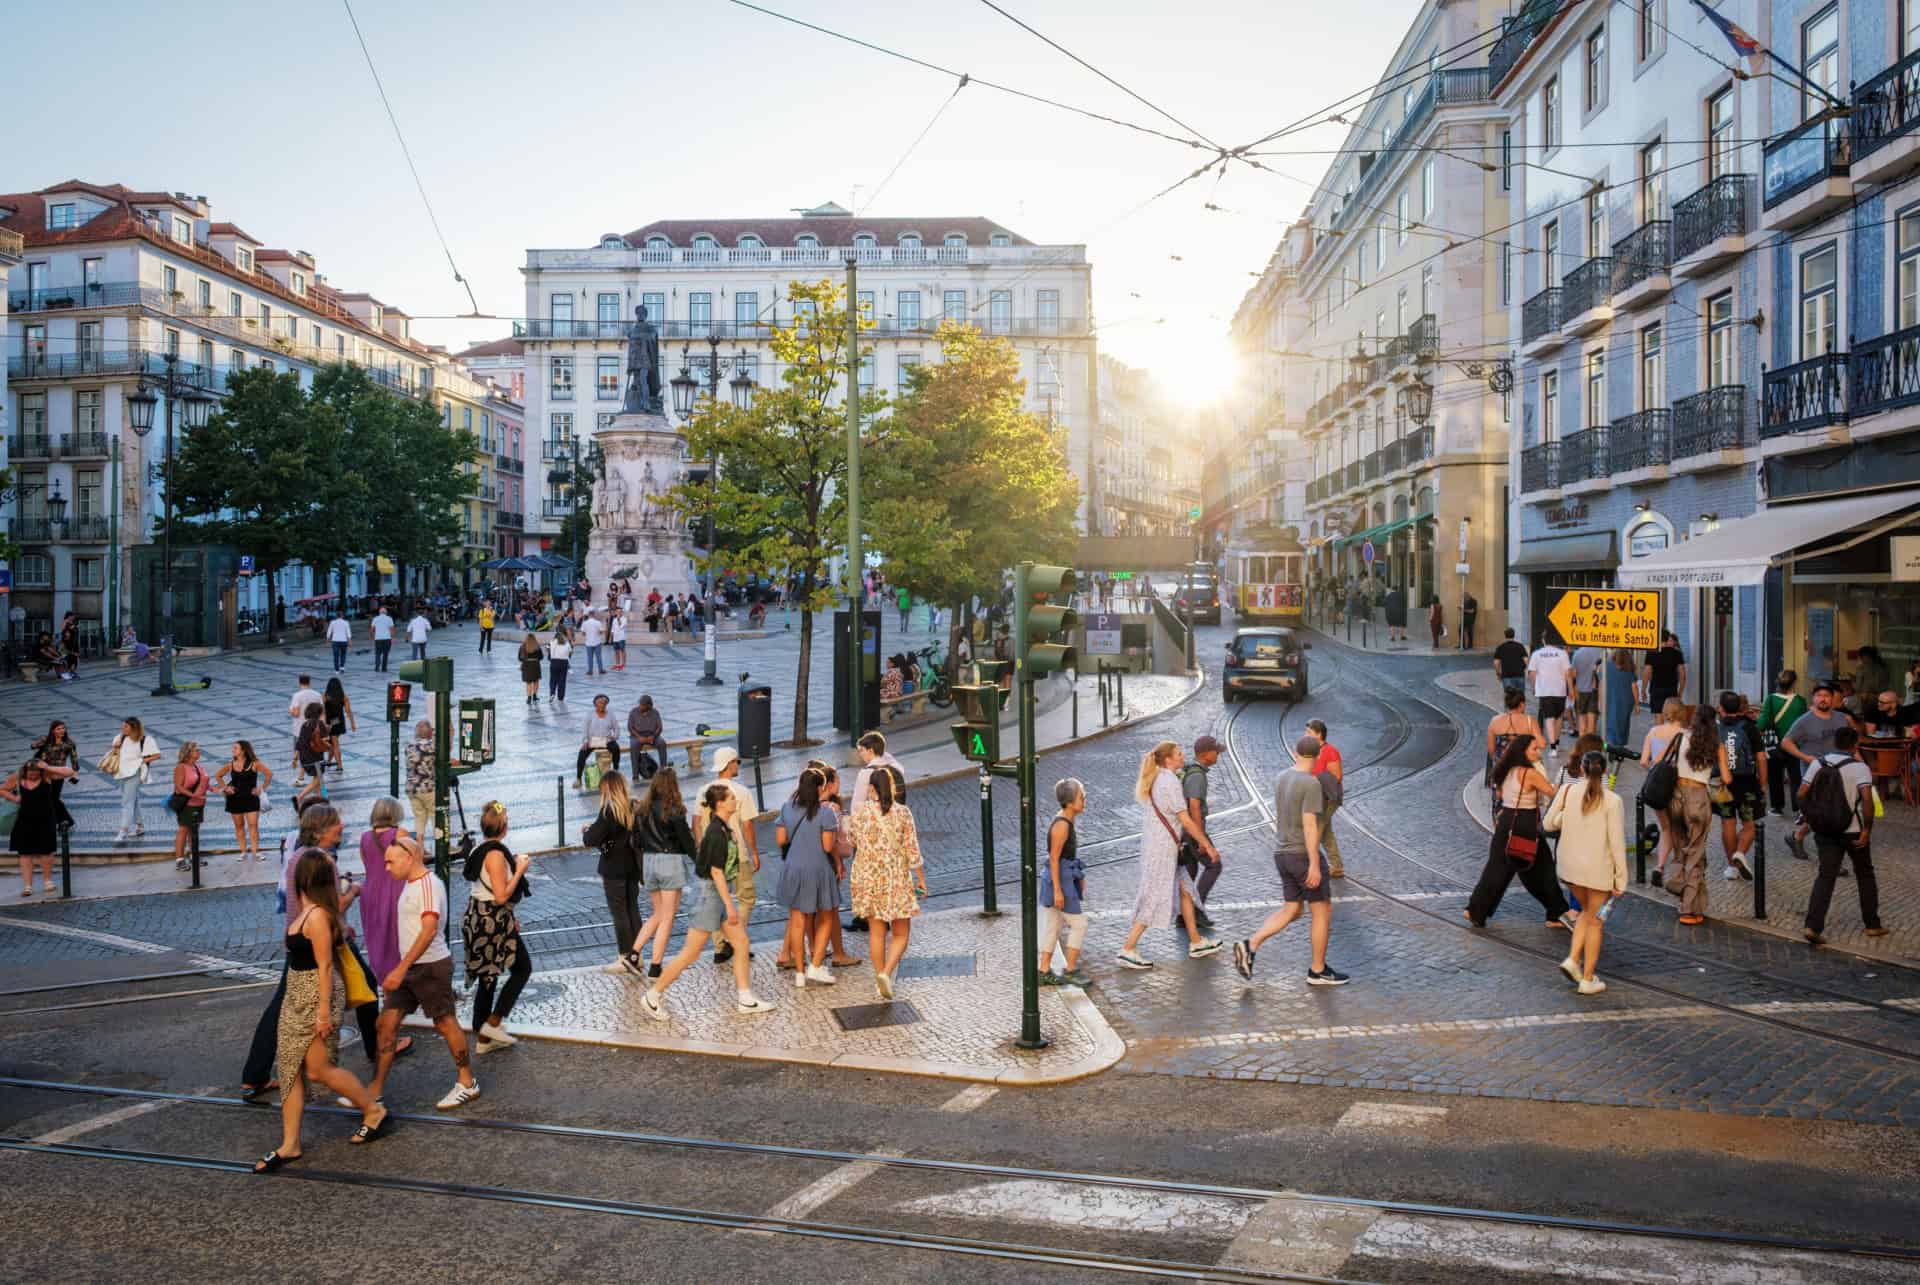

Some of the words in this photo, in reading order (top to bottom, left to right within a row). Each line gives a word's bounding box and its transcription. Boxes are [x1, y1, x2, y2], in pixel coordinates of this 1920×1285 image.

[1579, 593, 1646, 612] Desvio
[1098, 615, 1108, 630] P
[1570, 613, 1588, 627] Av.
[1593, 614, 1607, 627] 24
[1624, 615, 1655, 629] Julho
[1571, 629, 1586, 641] (via
[1591, 631, 1620, 643] Infante
[1624, 632, 1654, 646] Santo)
